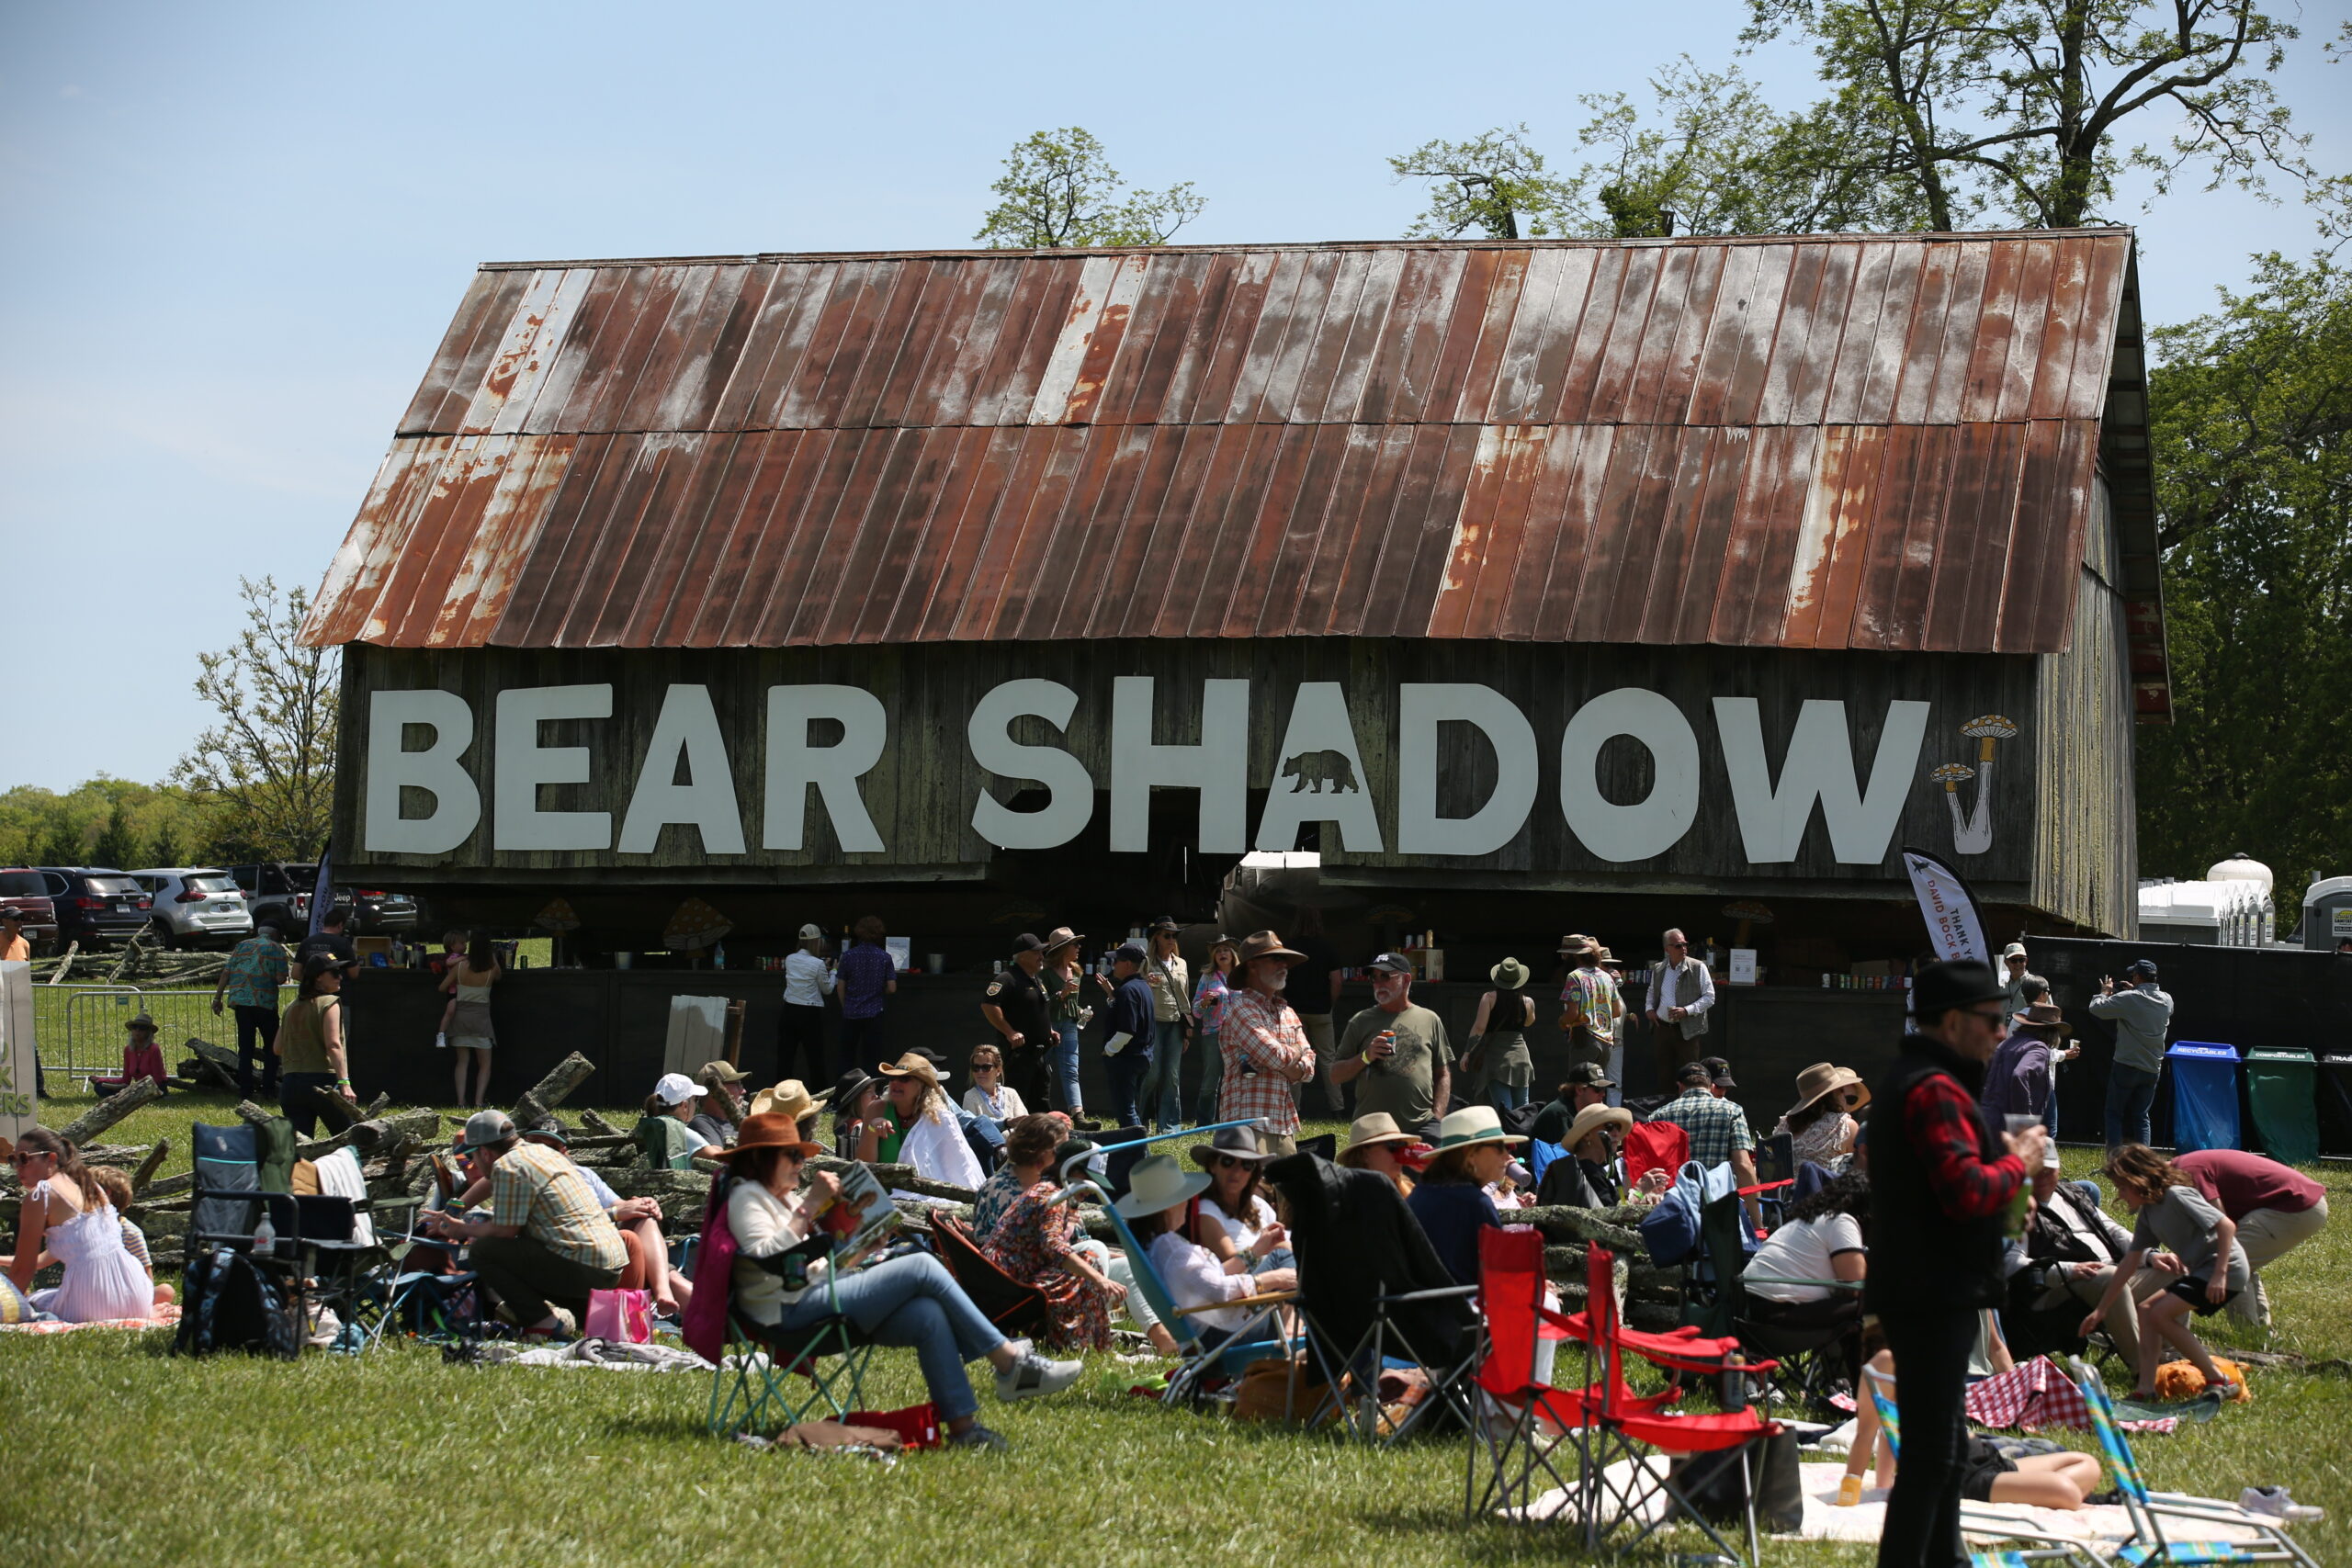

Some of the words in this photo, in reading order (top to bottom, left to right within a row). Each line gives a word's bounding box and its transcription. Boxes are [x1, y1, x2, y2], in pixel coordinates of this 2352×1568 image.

[365, 683, 887, 854] BEAR
[967, 675, 1931, 864] SHADOW
[334, 893, 351, 903] Jeep
[1928, 880, 1944, 913] DAVID
[1939, 917, 1957, 949] BOCK
[1951, 908, 1970, 946] THANK
[1964, 948, 1974, 962] YO
[2177, 1047, 2227, 1055] RECYCLABLES
